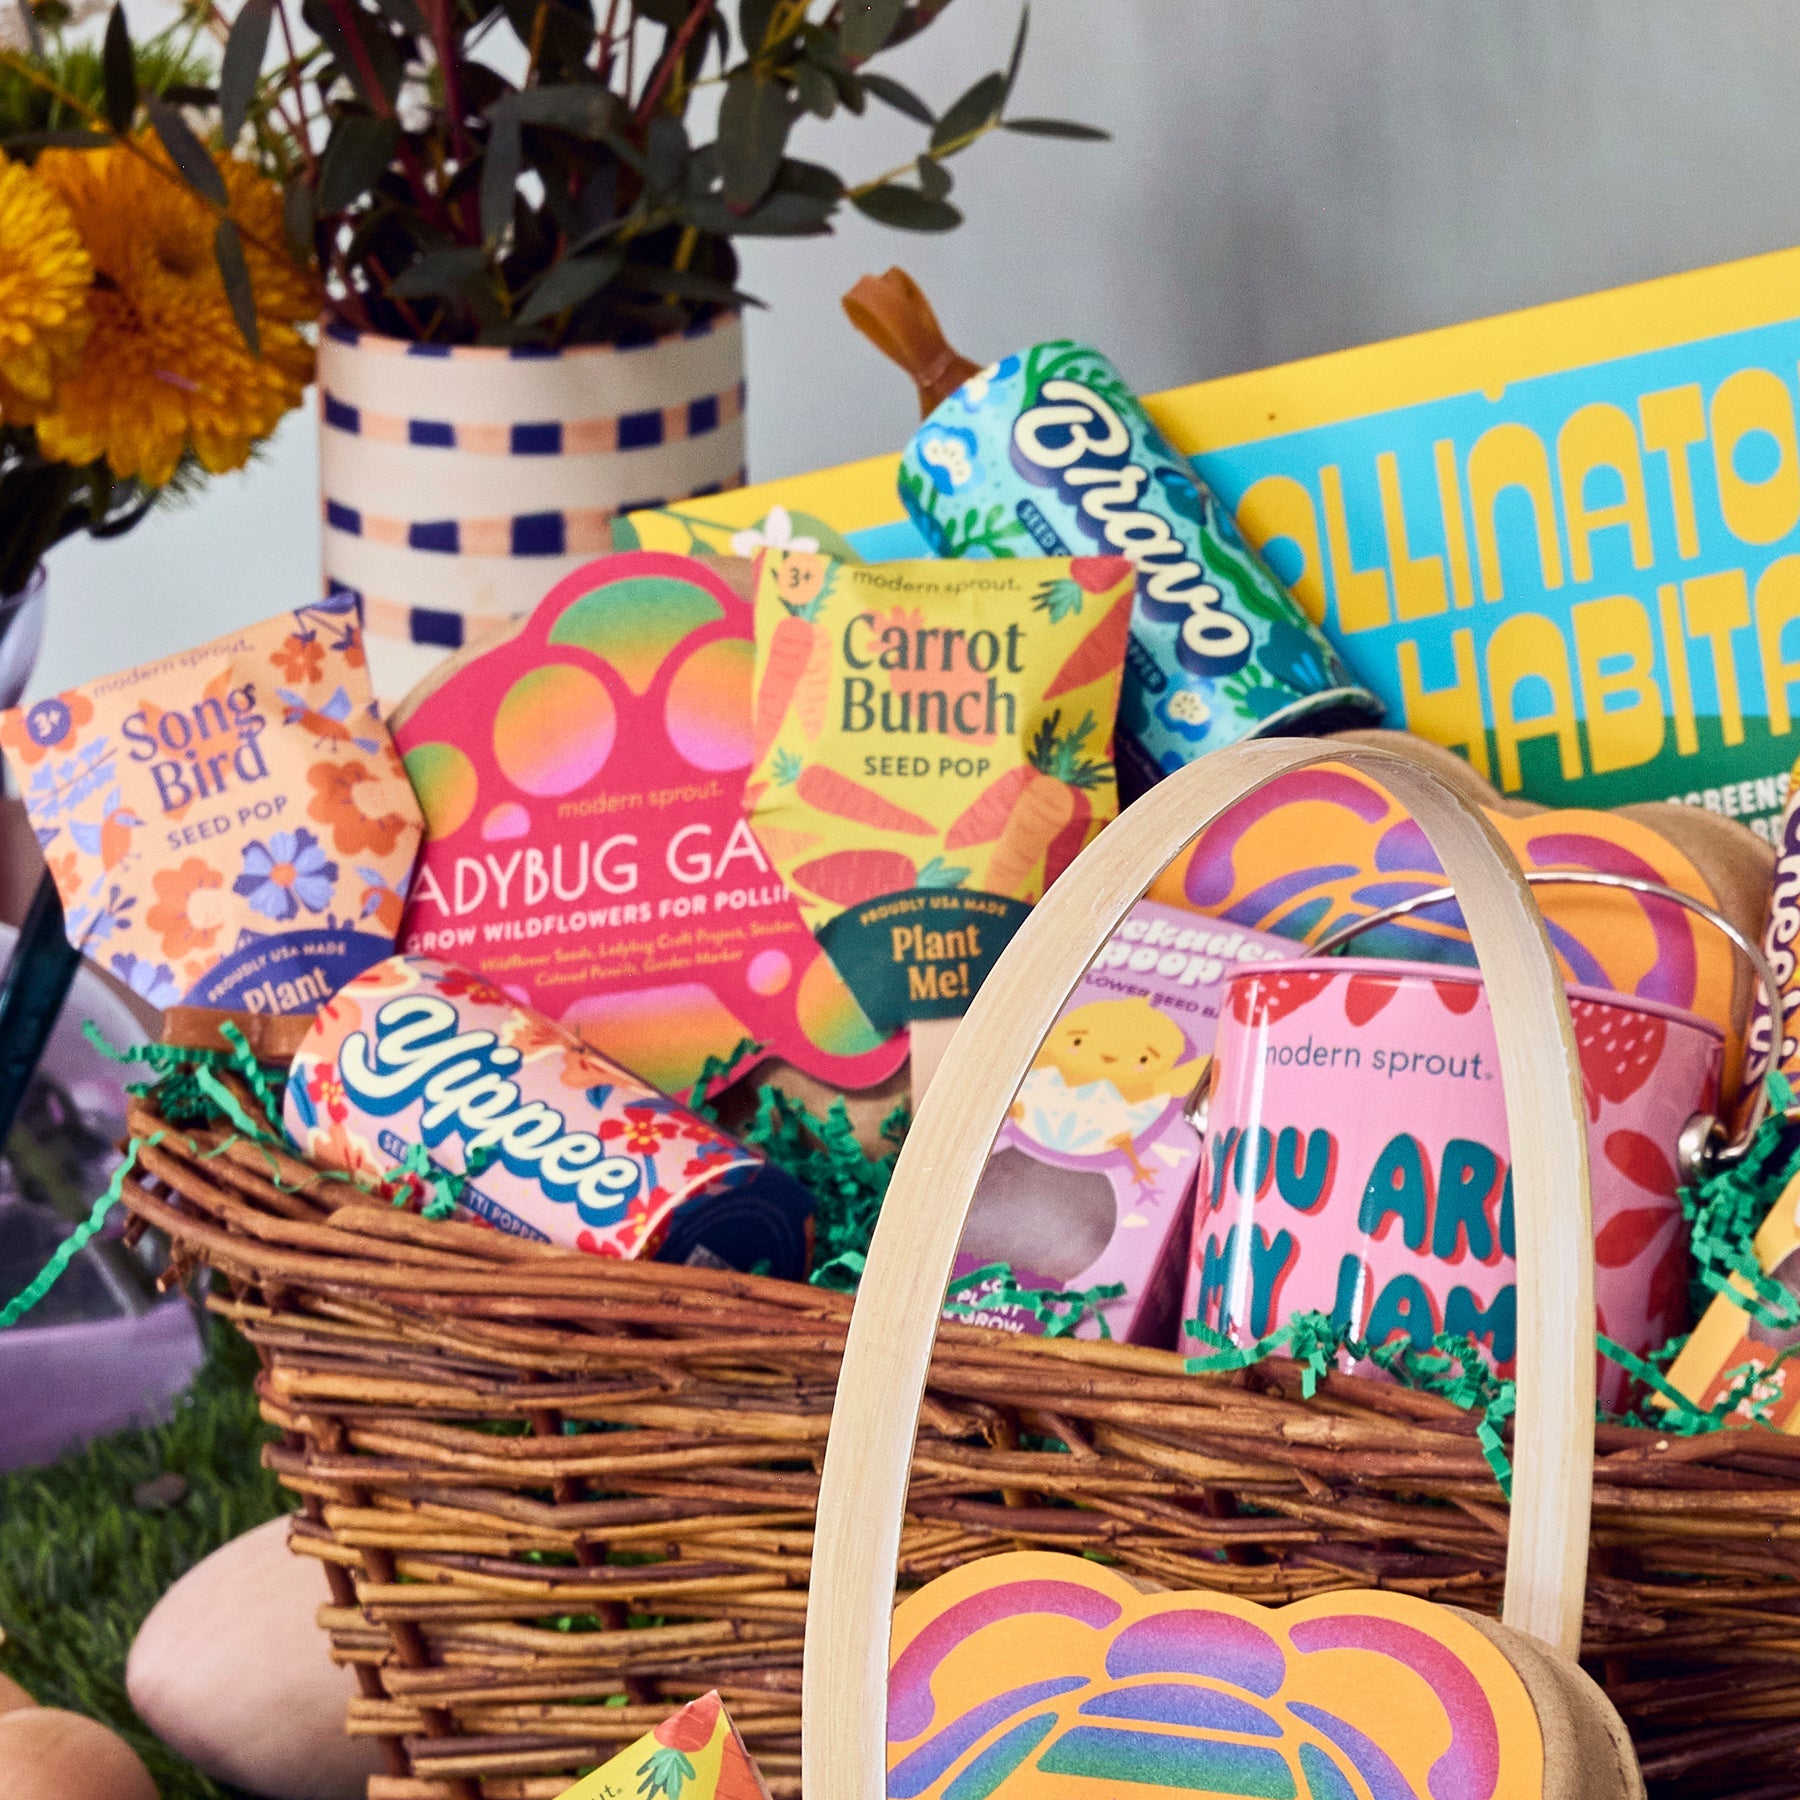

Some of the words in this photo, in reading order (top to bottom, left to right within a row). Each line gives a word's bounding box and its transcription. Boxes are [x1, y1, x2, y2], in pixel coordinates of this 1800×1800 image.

[1010, 379, 1252, 668] Bravo
[789, 568, 813, 588] 3+
[853, 570, 941, 593] modern
[843, 613, 1027, 673] Carrot
[121, 682, 266, 762] Song
[841, 676, 1017, 737] Bunch
[150, 728, 269, 812] Bird
[864, 756, 930, 777] SEED
[939, 757, 991, 777] POP
[167, 811, 231, 850] SEED
[238, 796, 289, 825] POP
[411, 834, 638, 917] ADYBUG
[483, 900, 652, 944] WILDFLOWERS
[660, 893, 706, 919] FOR
[890, 923, 982, 963] Plant
[242, 966, 333, 1015] Plant
[907, 962, 971, 1001] Me!
[338, 993, 643, 1218] Yippee
[1211, 1125, 1338, 1214] YOU
